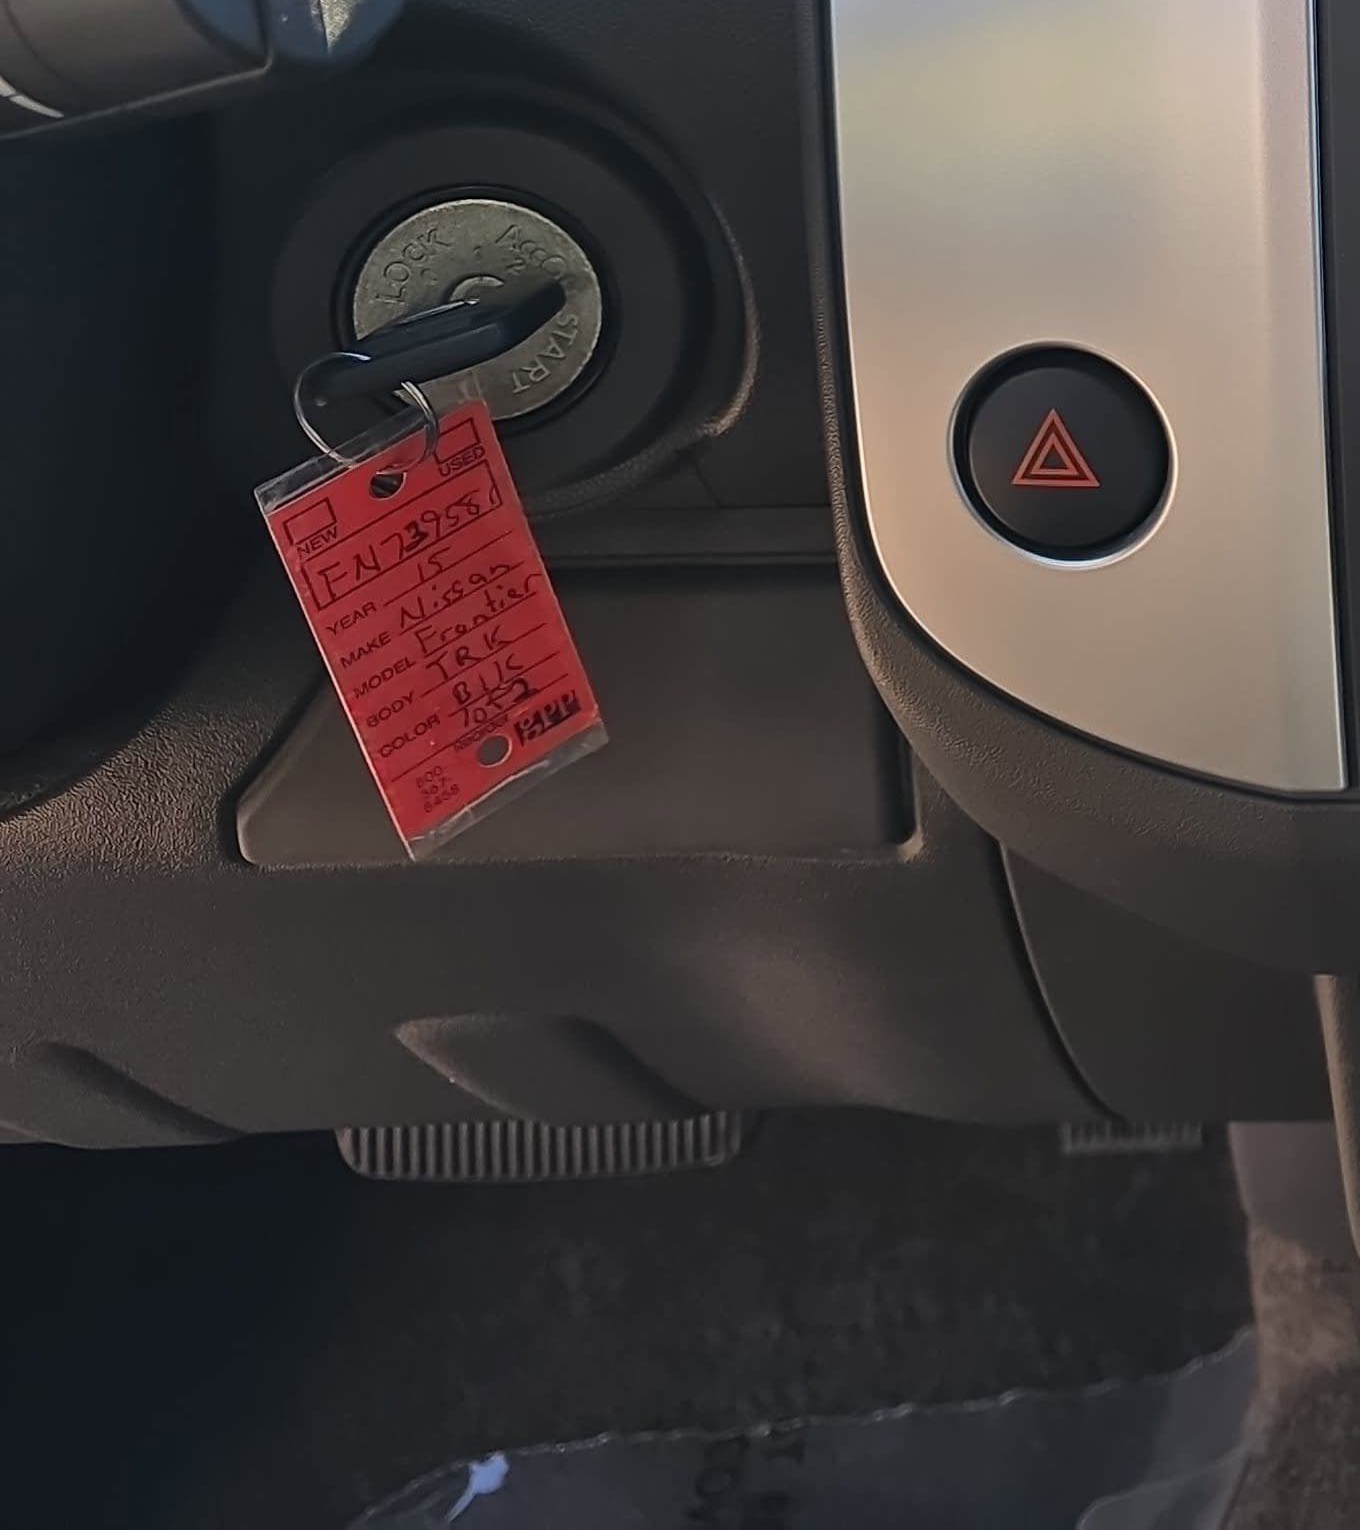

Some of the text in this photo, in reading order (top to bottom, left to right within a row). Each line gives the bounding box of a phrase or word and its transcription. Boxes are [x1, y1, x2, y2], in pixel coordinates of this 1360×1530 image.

[375, 228, 451, 305] LOCK
[512, 313, 578, 394] START
[439, 446, 485, 477] USED
[297, 526, 337, 555] NEW
[417, 547, 450, 582] 15
[400, 564, 510, 628] Nissan
[326, 602, 377, 635] YEAR
[340, 631, 392, 669] MAKE
[354, 656, 416, 698] MODEL
[366, 692, 414, 727] BODY
[380, 714, 440, 758] COLOR
